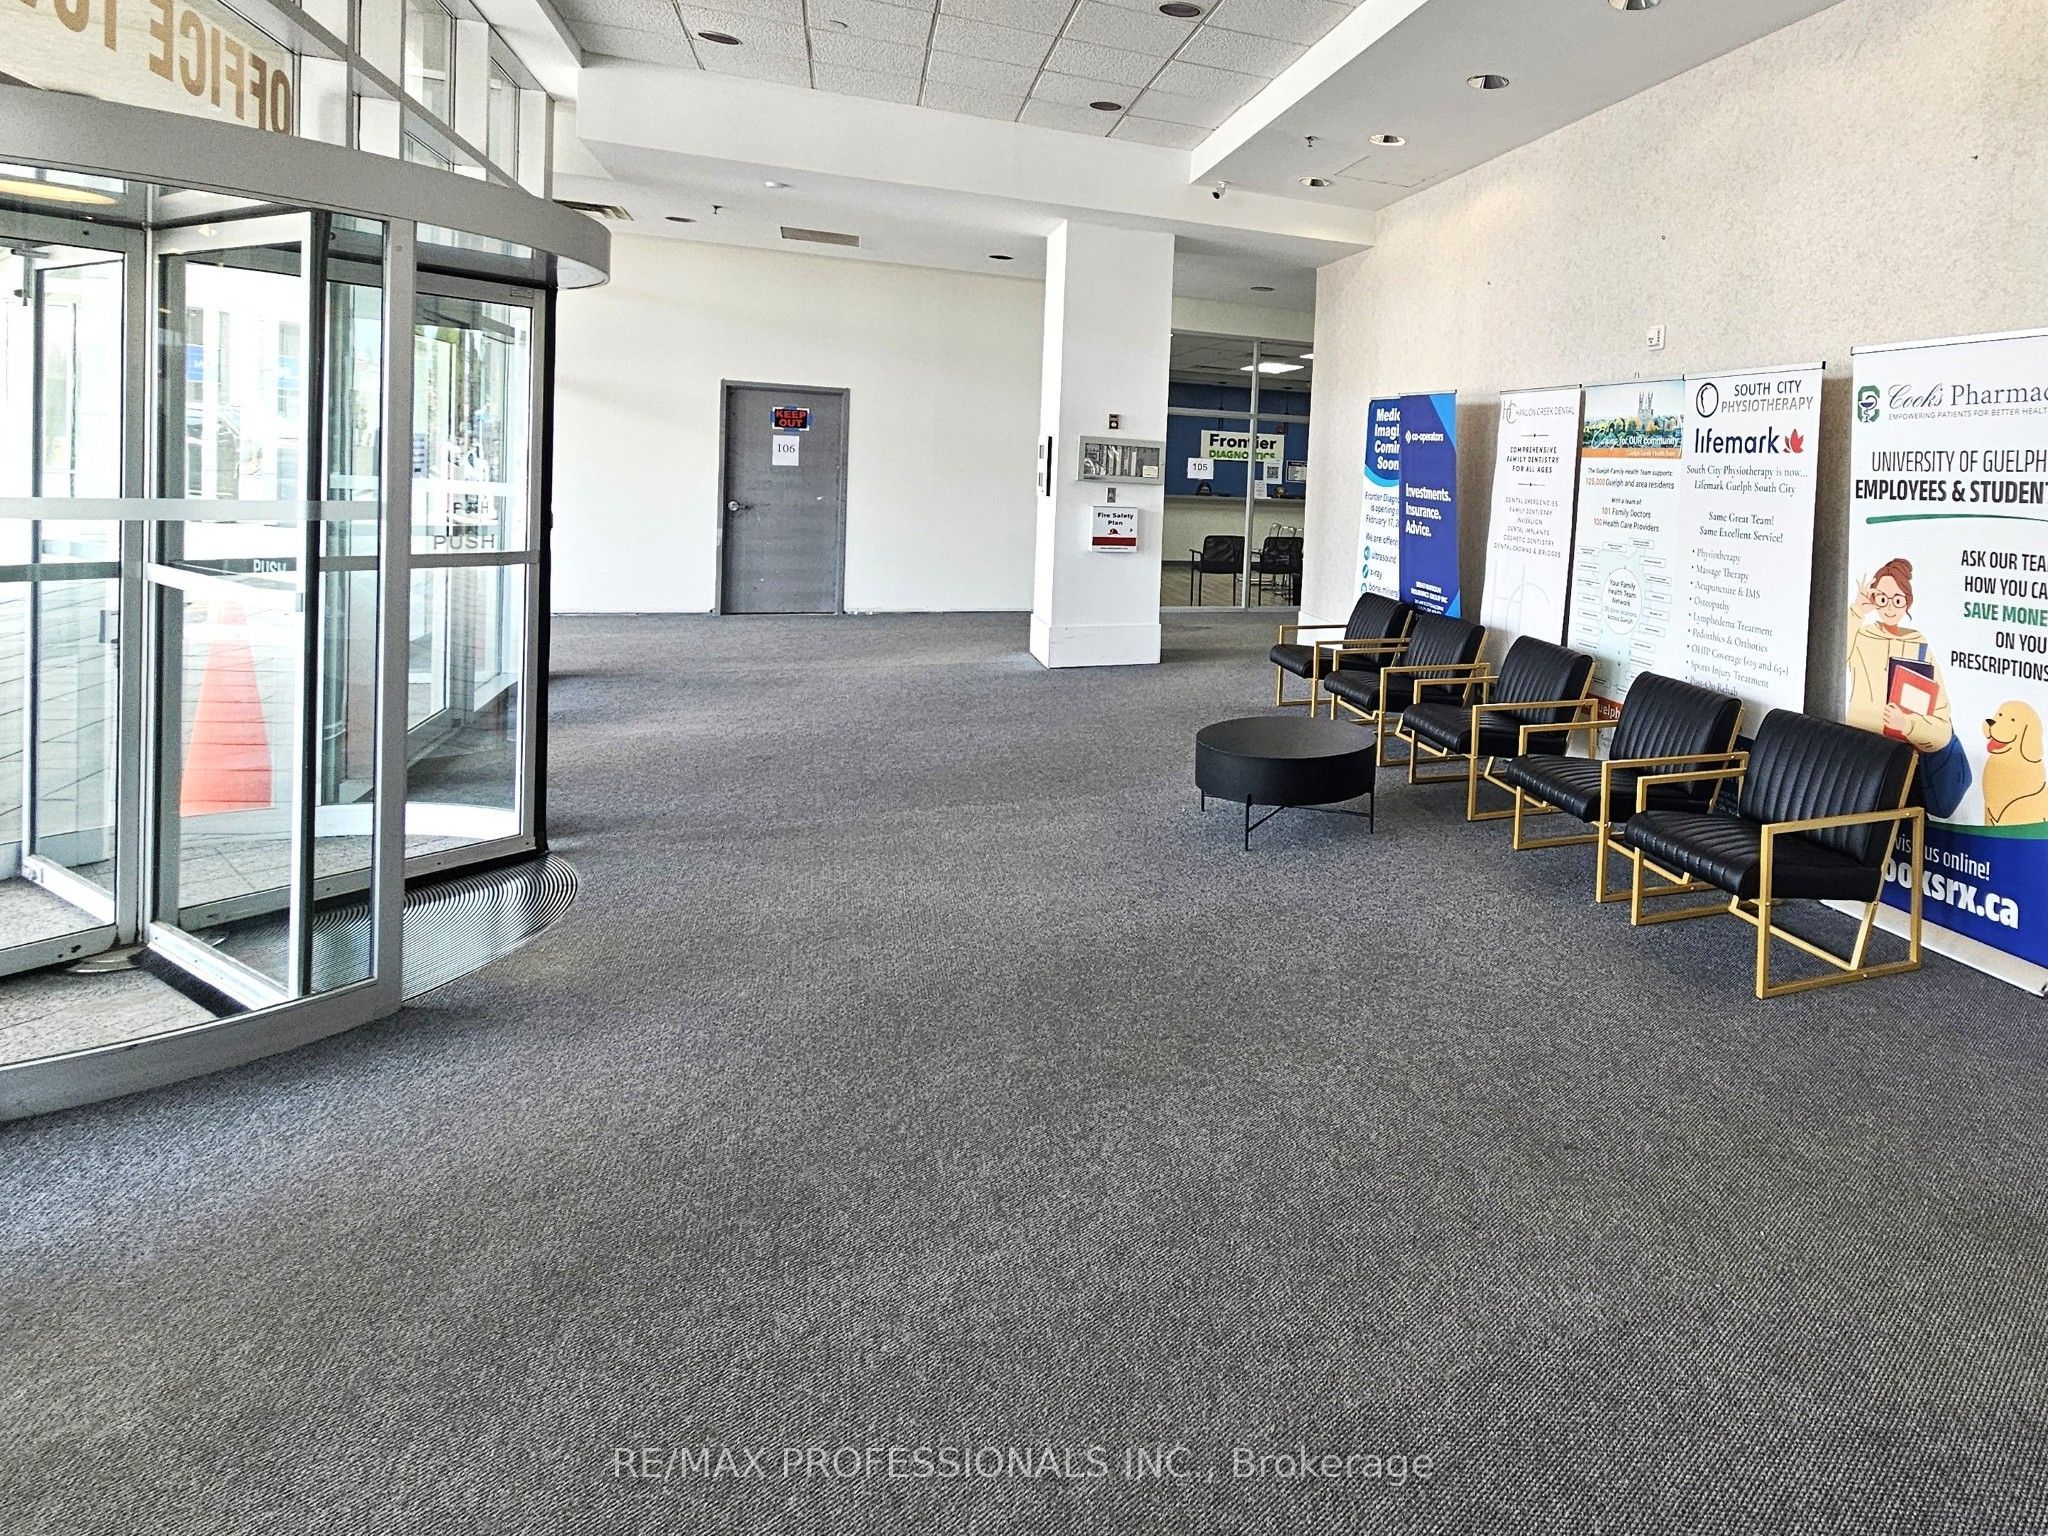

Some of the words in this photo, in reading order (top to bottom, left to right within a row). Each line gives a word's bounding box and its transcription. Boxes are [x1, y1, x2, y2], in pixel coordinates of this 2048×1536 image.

[1734, 383, 1771, 397] SOUTH
[1777, 380, 1802, 394] CITY
[1555, 406, 1575, 416] DENTAL
[1721, 396, 1814, 413] PHYSIOTHERAPY
[776, 410, 806, 419] KEEP
[1888, 412, 1936, 420] EMPOWERING
[1937, 410, 1972, 418] PATIENTS
[1973, 409, 1989, 417] FOR
[1991, 408, 2020, 416] BETTER
[779, 419, 803, 427] OUT
[1209, 434, 1277, 450] Fronier
[1412, 432, 1444, 444] co-operators
[1643, 436, 1679, 447] community
[1694, 426, 1780, 454] lifemark
[778, 444, 796, 453] 106
[1193, 463, 1208, 471] 105
[1377, 456, 1399, 470] Soon
[1871, 450, 1955, 473] UNIVERSITY
[1959, 451, 1978, 473] OF
[1983, 450, 2048, 473] GUELPH
[1686, 465, 1706, 475] South
[1707, 466, 1721, 478] City
[1723, 465, 1774, 479] Physiotherapy
[1776, 467, 1782, 476] is
[1405, 483, 1452, 502] Investments.
[1606, 479, 1624, 488] Guelph
[1624, 479, 1634, 487] and
[1635, 480, 1647, 488] area
[1648, 481, 1675, 490] residents
[1694, 480, 1724, 490] Lifemark
[1725, 481, 1752, 494] Guelph
[1754, 482, 1777, 493] South
[1779, 483, 1795, 497] City
[1855, 479, 1947, 501] EMPLOYEES
[1952, 480, 1966, 502] &
[1405, 502, 1442, 520] Insurance.
[1611, 507, 1630, 519] Family
[1631, 509, 1651, 519] Doctors
[1708, 512, 1727, 522] Same
[1728, 512, 1749, 524] Great
[1751, 514, 1774, 526] Team!
[1405, 520, 1432, 537] Advice.
[1602, 519, 1620, 528] Health
[1620, 520, 1632, 529] Care
[1634, 522, 1660, 533] Providers
[1699, 526, 1718, 537] Same
[1719, 528, 1751, 540] Excellent
[1753, 531, 1784, 543] Service!
[433, 534, 495, 550] PUSH
[1696, 548, 1741, 565] Physiotherapy
[1961, 549, 1986, 568] ASK
[1989, 551, 2017, 570] OUR
[2021, 553, 2048, 573] TEA
[1696, 564, 1722, 578] Massage
[1723, 567, 1749, 583] Therapy
[1694, 580, 1736, 596] Acupuncture
[1737, 589, 1744, 597] &
[1745, 587, 1761, 599] IMS
[1964, 576, 1997, 594] HOW
[2000, 578, 2027, 598] YOU
[1693, 596, 1730, 614] Osteopathy
[1963, 601, 1999, 621] SAVE
[1692, 611, 1735, 629] Lymphedema
[1736, 620, 1773, 637] Treatment
[1692, 628, 1725, 643] Pedorthics
[1726, 636, 1733, 645] &
[1734, 637, 1768, 653] Orthotics
[1995, 631, 2015, 650] ON
[1691, 644, 1711, 656] OHIP
[1711, 648, 1743, 665] Coverage
[1758, 661, 1772, 672] and
[1950, 650, 2048, 682] PRESCRIPTIONS
[1690, 659, 1710, 673] Sports
[1711, 664, 1731, 681] Injury
[1733, 670, 1769, 688] Treatment
[1717, 682, 1738, 697] Rehab
[1924, 847, 1939, 863] us
[1943, 851, 1990, 881] online!
[1884, 858, 2019, 930] ooksrx.ca
